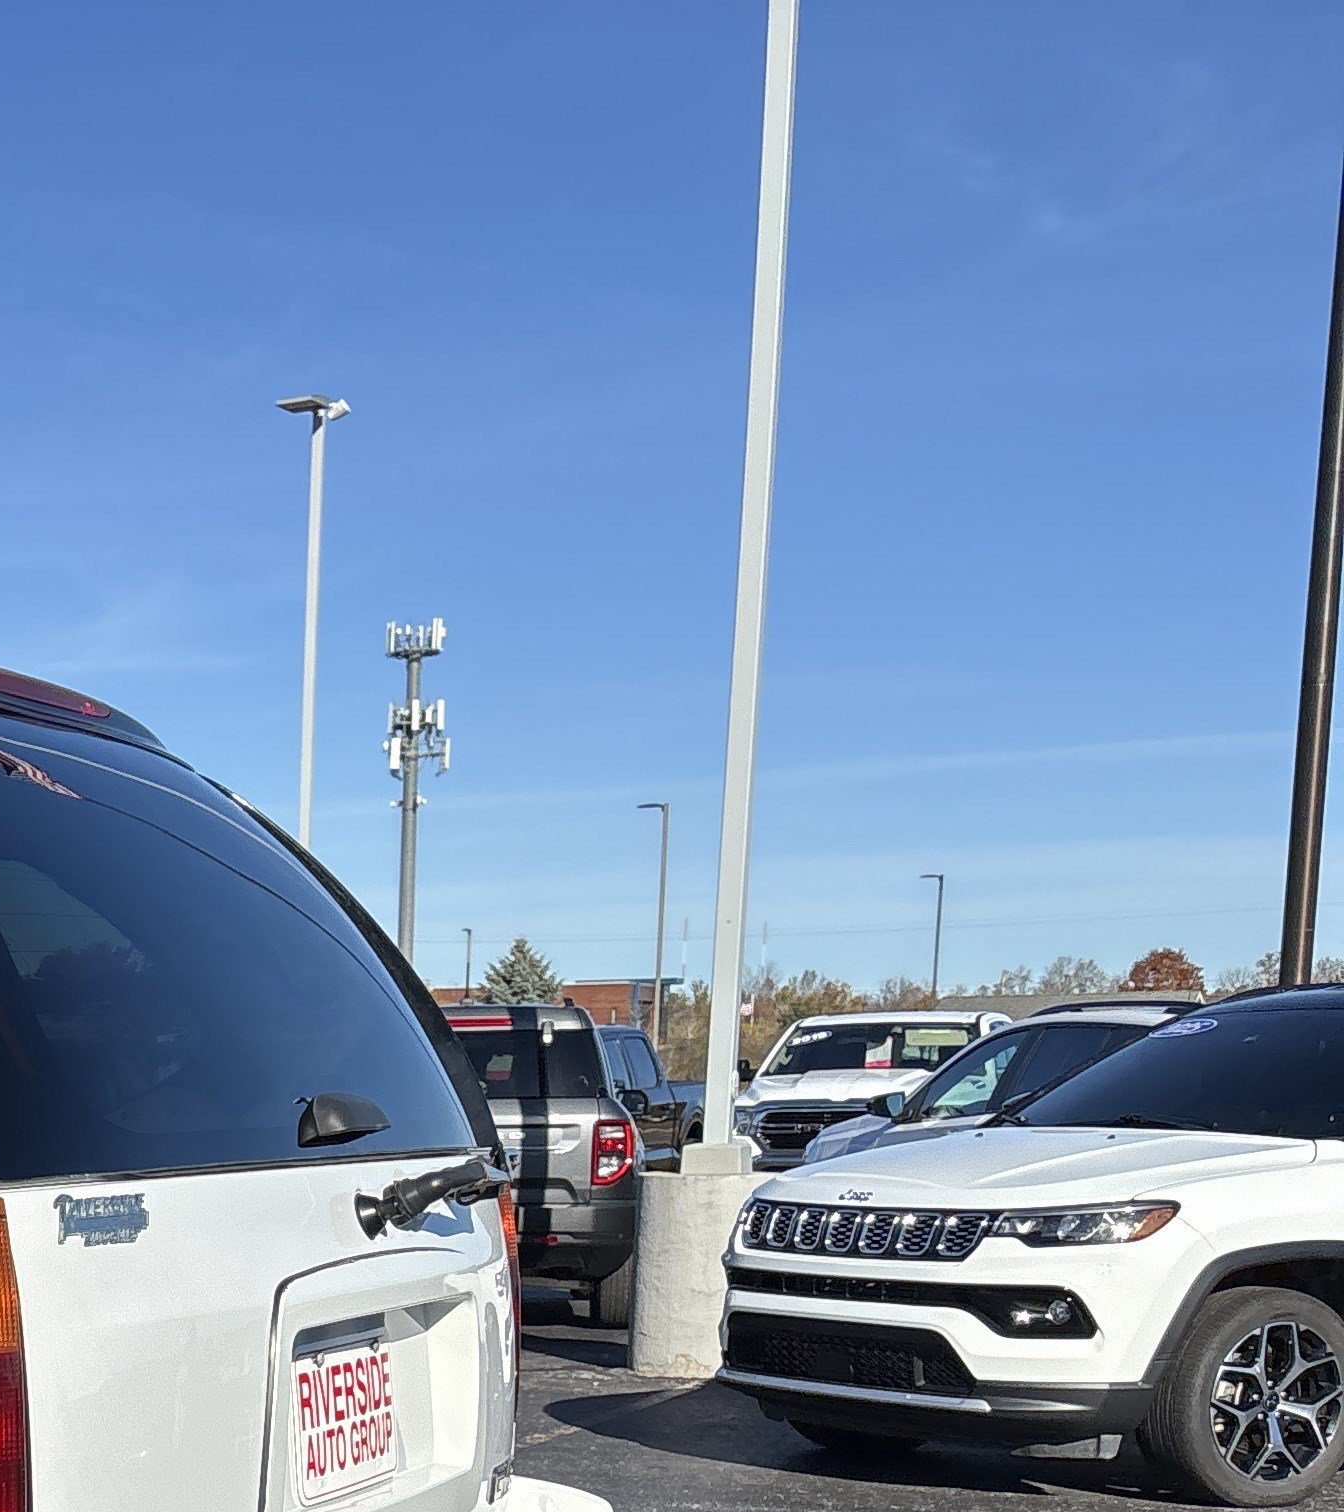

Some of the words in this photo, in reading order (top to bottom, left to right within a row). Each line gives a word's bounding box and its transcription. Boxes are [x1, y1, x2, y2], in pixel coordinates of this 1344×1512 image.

[298, 1352, 393, 1431] RIVERSIDE
[306, 1424, 347, 1481] AUTO
[350, 1411, 393, 1466] GROUP
